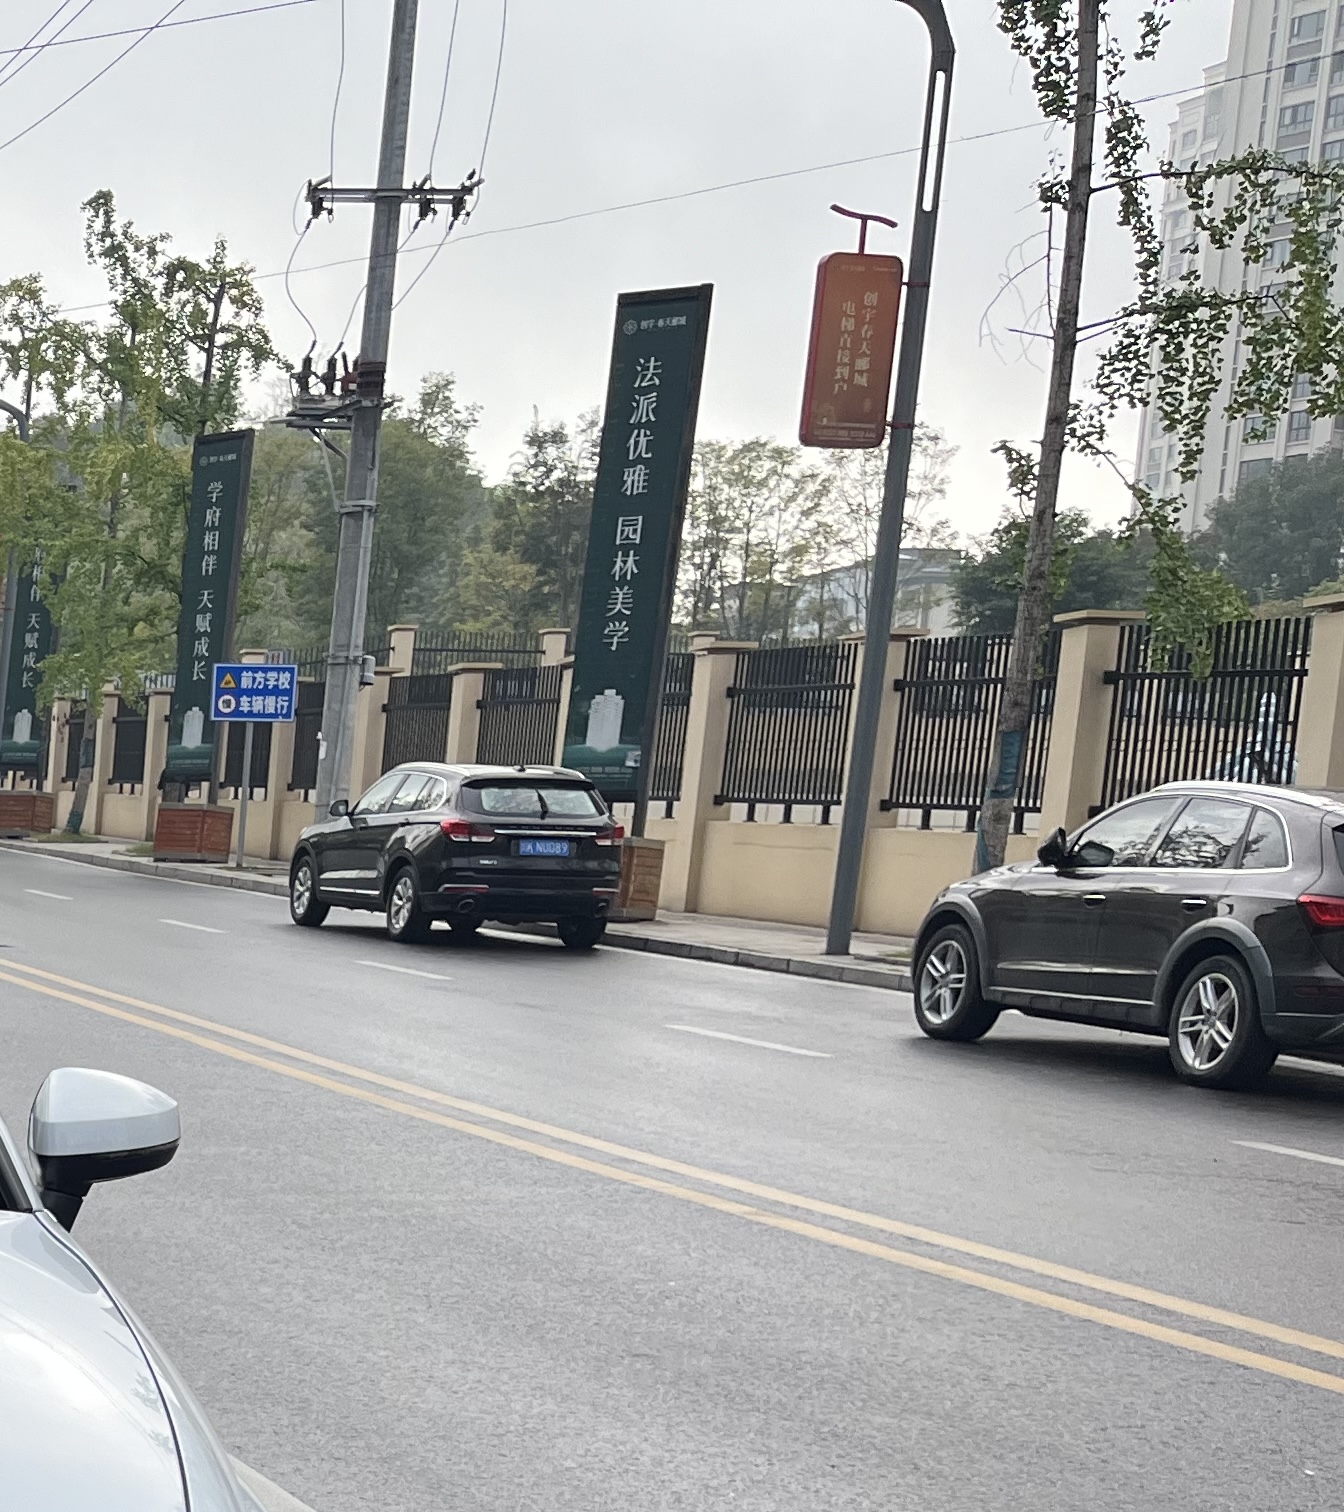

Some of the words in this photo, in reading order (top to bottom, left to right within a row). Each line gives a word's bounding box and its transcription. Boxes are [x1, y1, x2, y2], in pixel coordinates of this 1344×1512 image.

[832, 300, 856, 396] 电梯直接到户
[621, 356, 663, 496] 法派优雅
[201, 480, 224, 576] 学府相伴
[602, 515, 643, 651] 园林美学
[192, 589, 215, 681] 天赋成长
[240, 670, 292, 690] 前方学校
[238, 694, 290, 715] 车辆慢行
